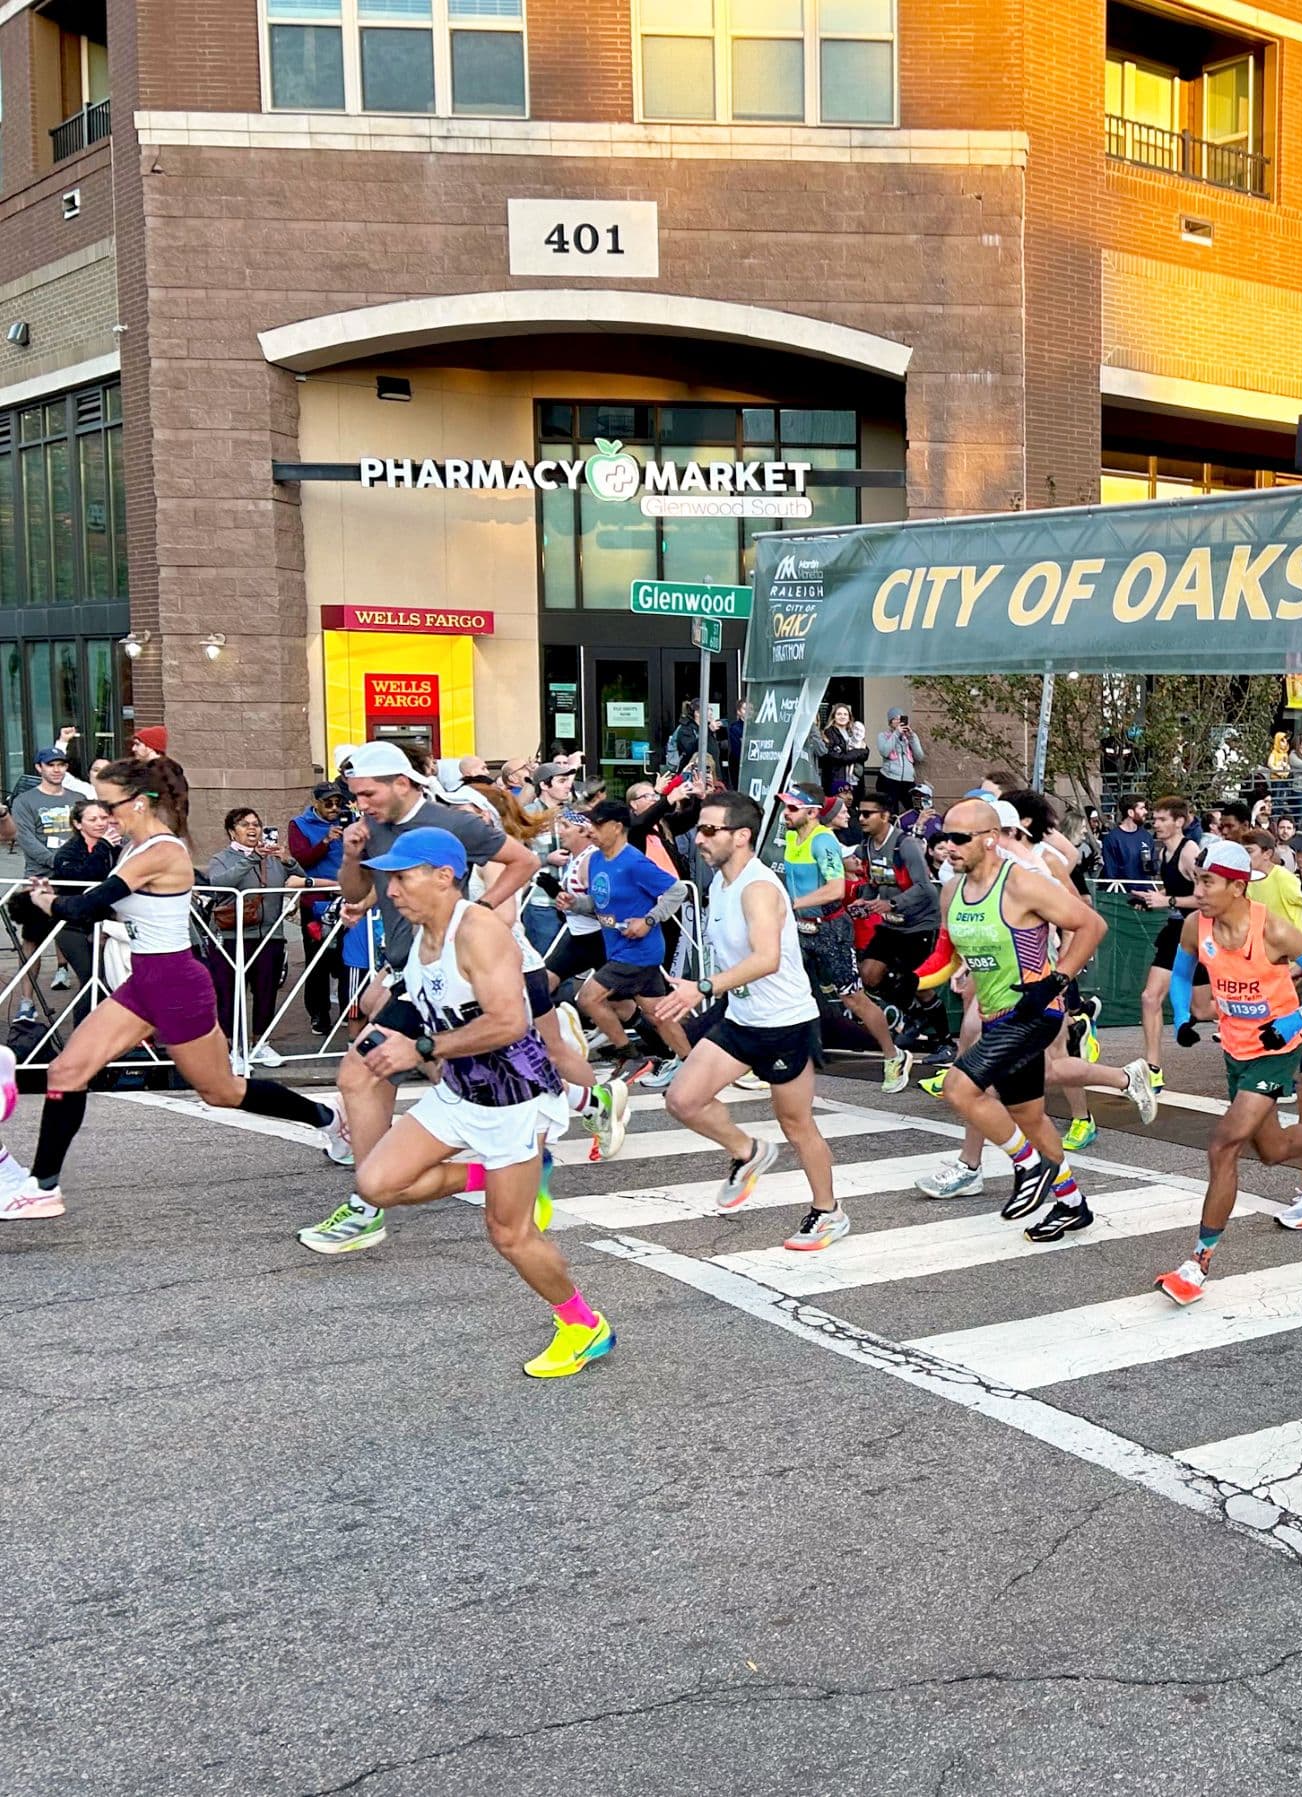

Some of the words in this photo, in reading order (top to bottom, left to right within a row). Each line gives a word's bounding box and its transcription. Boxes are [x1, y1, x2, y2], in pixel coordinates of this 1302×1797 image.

[544, 223, 625, 254] 401
[359, 457, 584, 491] PHARMACY
[644, 461, 813, 493] MARKET
[646, 497, 743, 517] Glenwood
[751, 497, 808, 517] South
[638, 585, 736, 614] Glenwood
[770, 586, 824, 597] RALEIGH
[872, 563, 1005, 634] CITY
[1007, 557, 1106, 627] OF
[785, 604, 803, 612] CITY
[805, 604, 817, 612] OF
[355, 610, 421, 626] WELLS
[425, 614, 486, 628] FARGO
[773, 612, 818, 638] OAKS
[371, 680, 431, 693] WELLS
[374, 695, 431, 708] FARGO
[968, 956, 997, 968] 5082
[1217, 979, 1261, 994] HBPR
[1231, 1004, 1266, 1015] 11399
